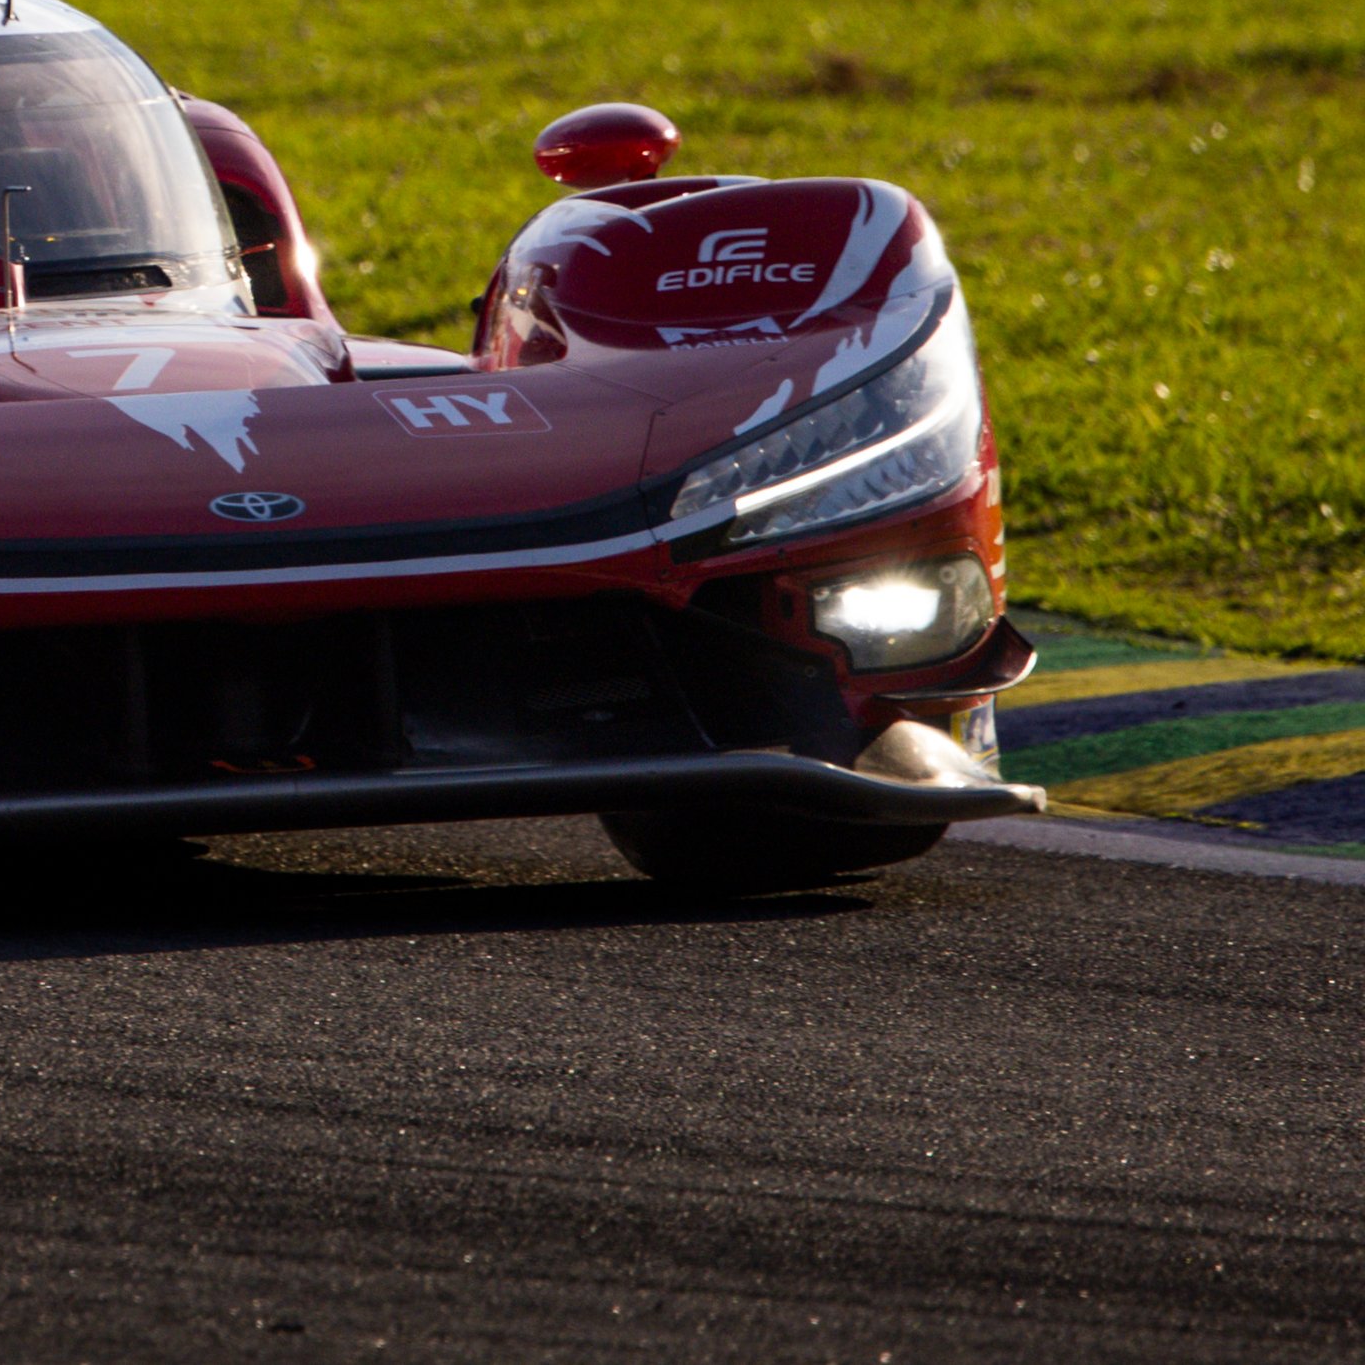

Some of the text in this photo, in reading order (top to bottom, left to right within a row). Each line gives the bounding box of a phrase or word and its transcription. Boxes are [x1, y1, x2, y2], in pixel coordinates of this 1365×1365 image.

[656, 262, 816, 292] EDIFICE
[669, 335, 789, 352] MARELLI
[65, 346, 177, 391] 7
[389, 391, 515, 430] HY
